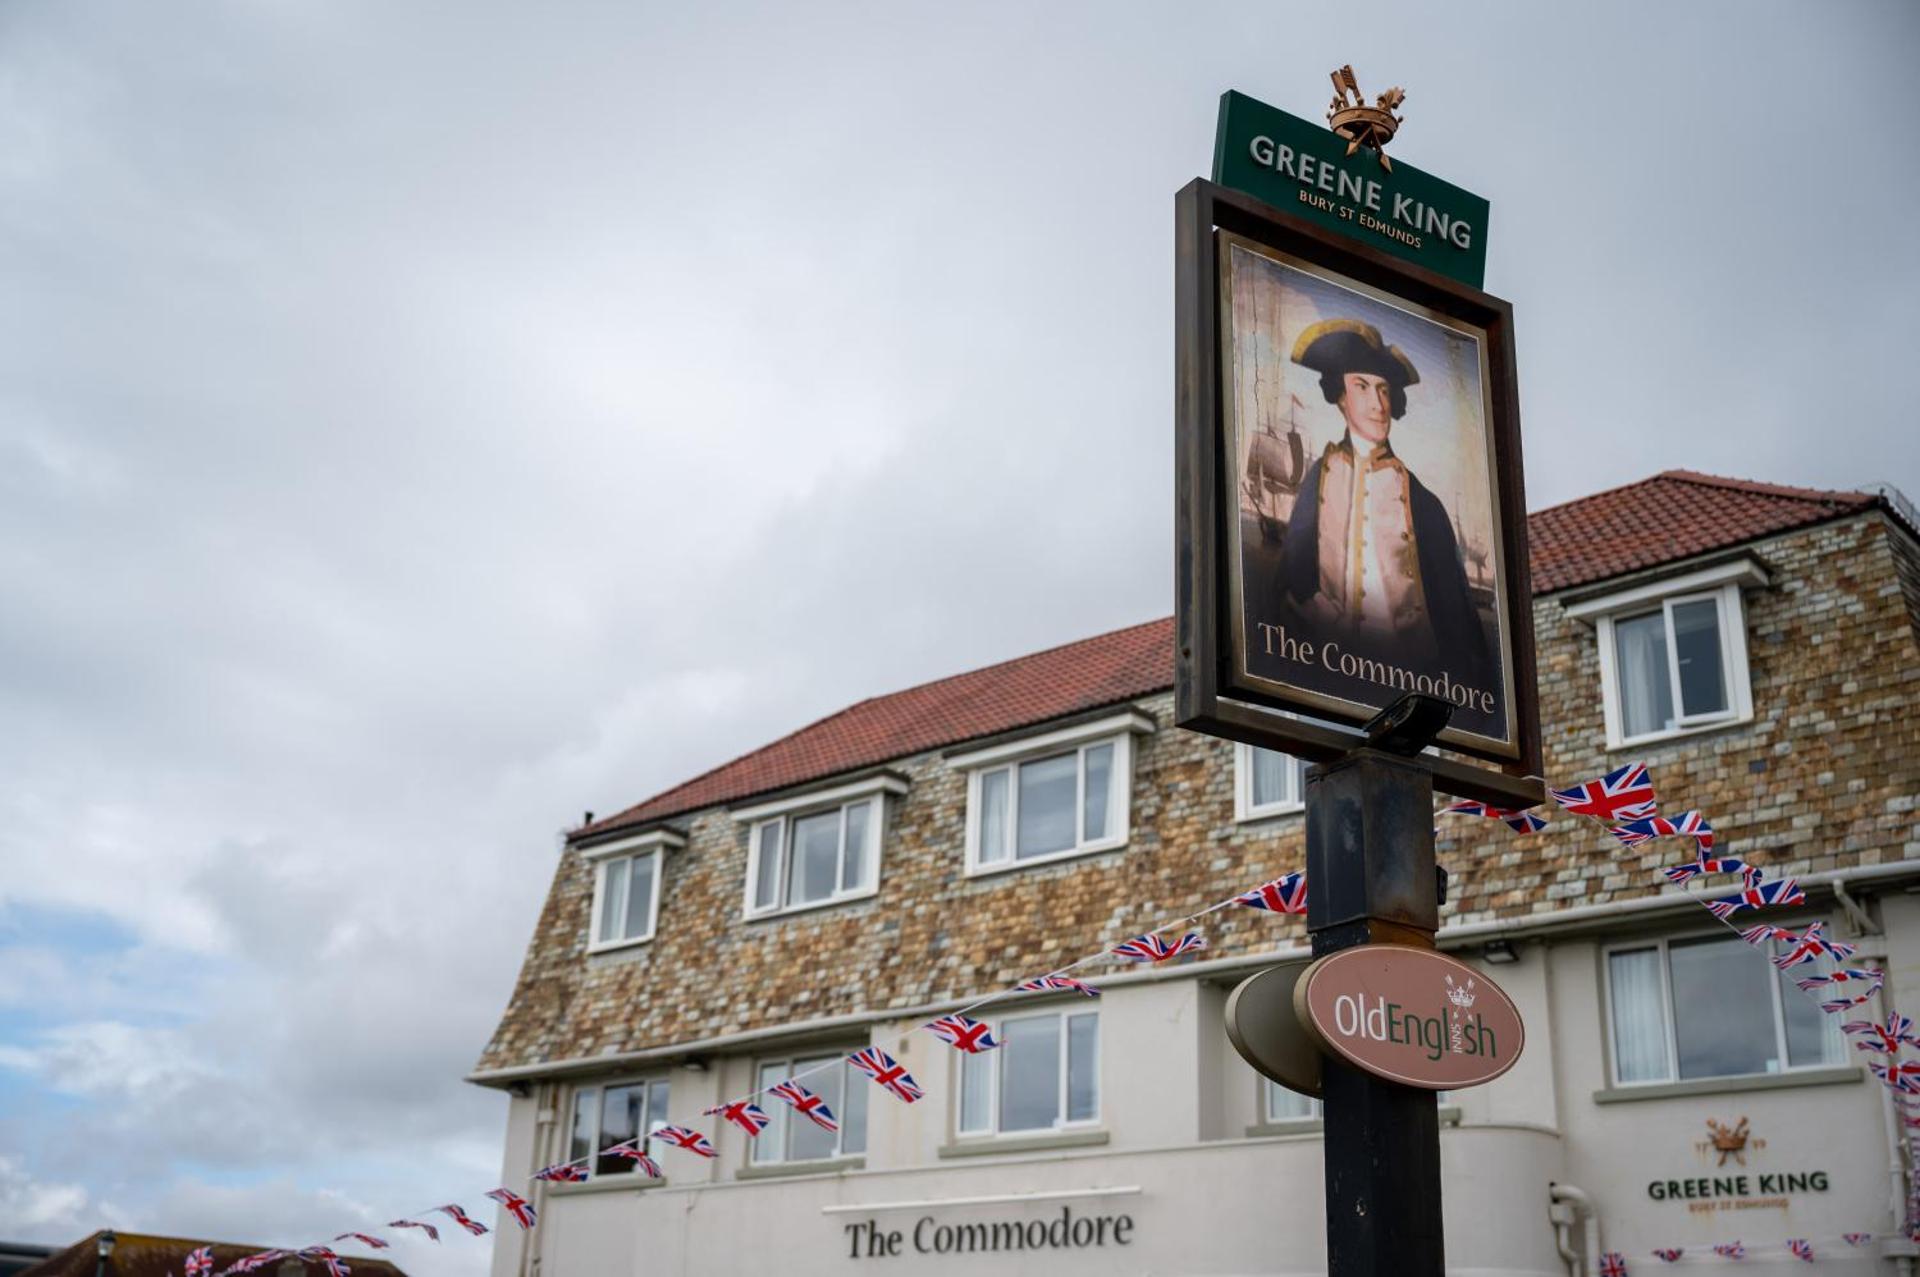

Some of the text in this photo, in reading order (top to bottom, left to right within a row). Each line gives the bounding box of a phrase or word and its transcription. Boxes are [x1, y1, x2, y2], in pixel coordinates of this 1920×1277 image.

[1250, 135, 1471, 250] GREENE KING
[1299, 189, 1422, 249] BURY ST EDMUNDS
[1258, 622, 1494, 714] The Commodore
[1648, 1171, 1829, 1201] GREENE KING
[845, 1205, 1135, 1259] The Commodore
